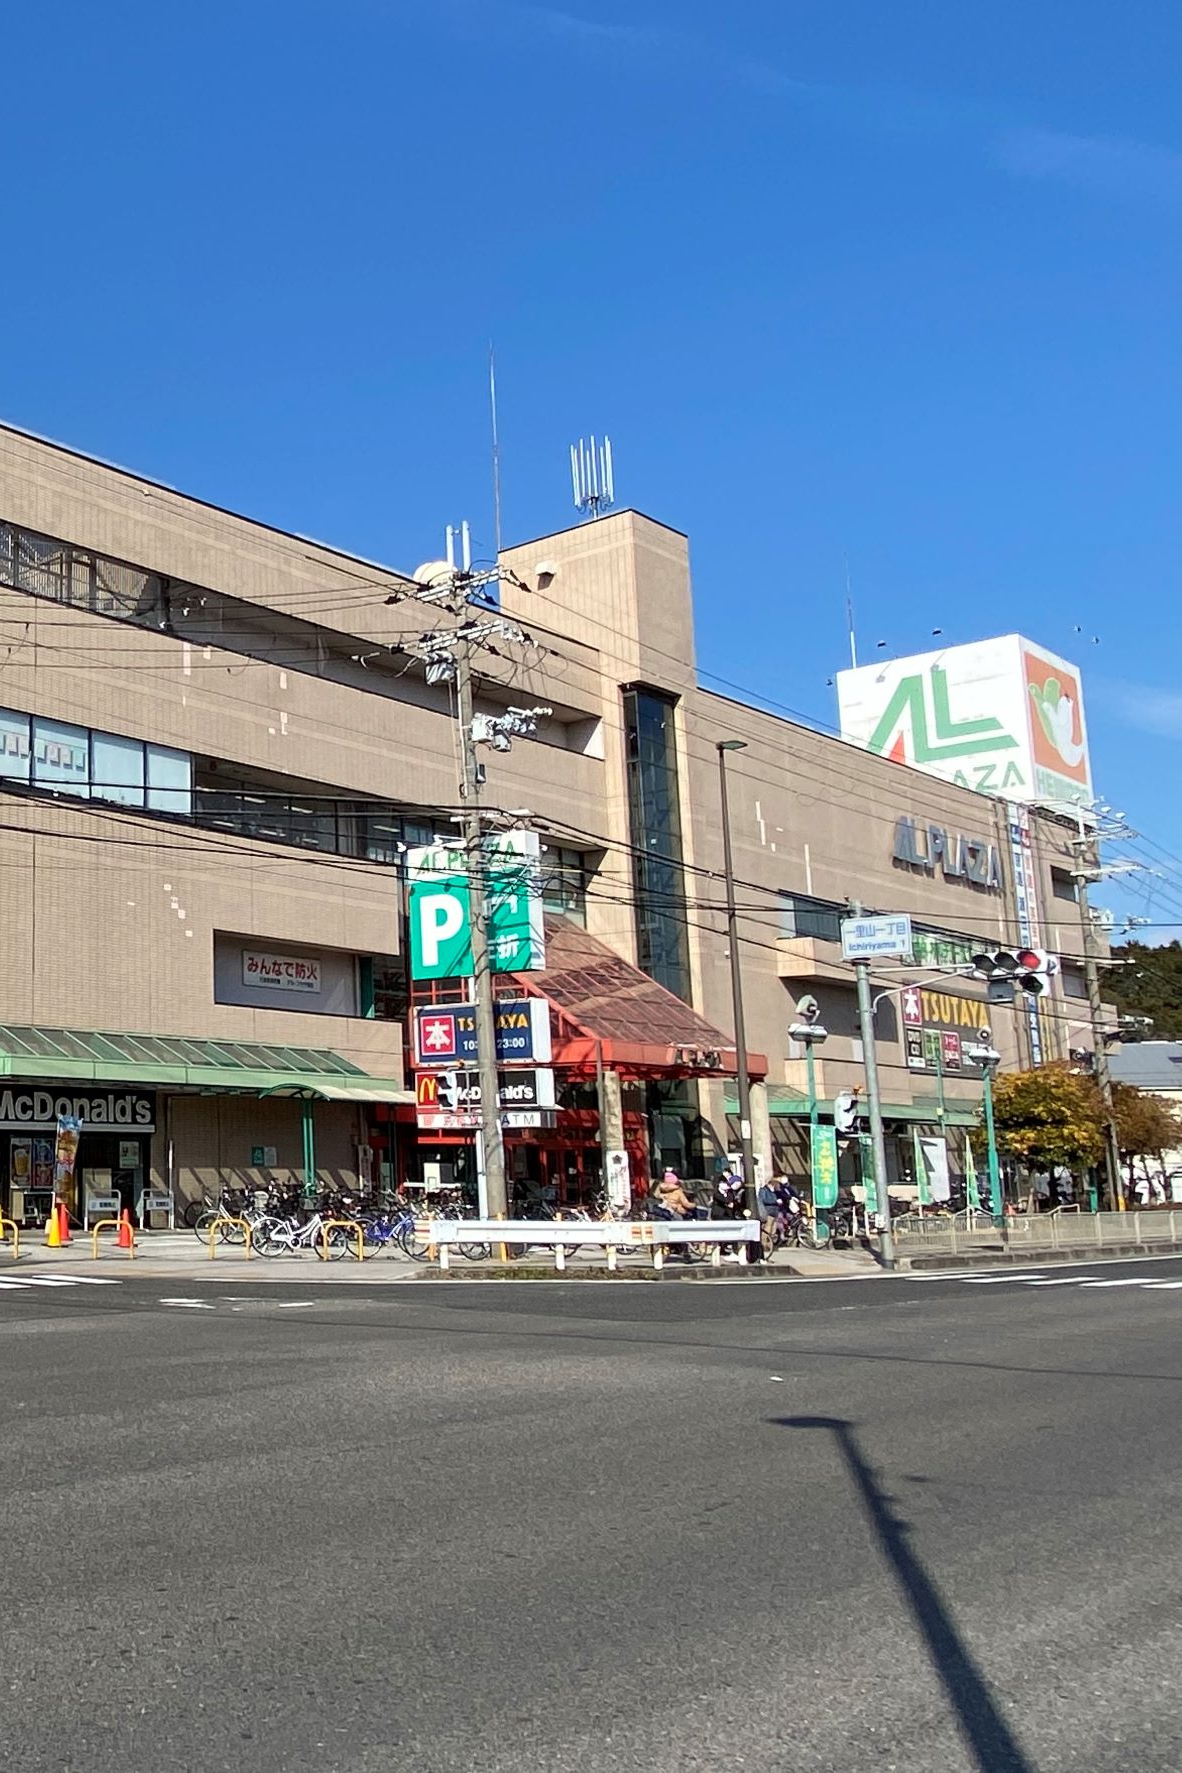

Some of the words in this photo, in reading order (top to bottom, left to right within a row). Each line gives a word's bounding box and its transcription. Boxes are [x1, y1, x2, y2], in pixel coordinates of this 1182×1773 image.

[953, 761, 1026, 793] AZA
[419, 893, 464, 967] P
[845, 921, 907, 938] 一里山一丁目
[849, 942, 897, 951] Ichiriyama
[246, 956, 318, 981] みんなで防火
[921, 991, 990, 1028] TSUTAYA
[458, 1013, 529, 1031] TSAYA
[500, 1113, 535, 1128] ATM
